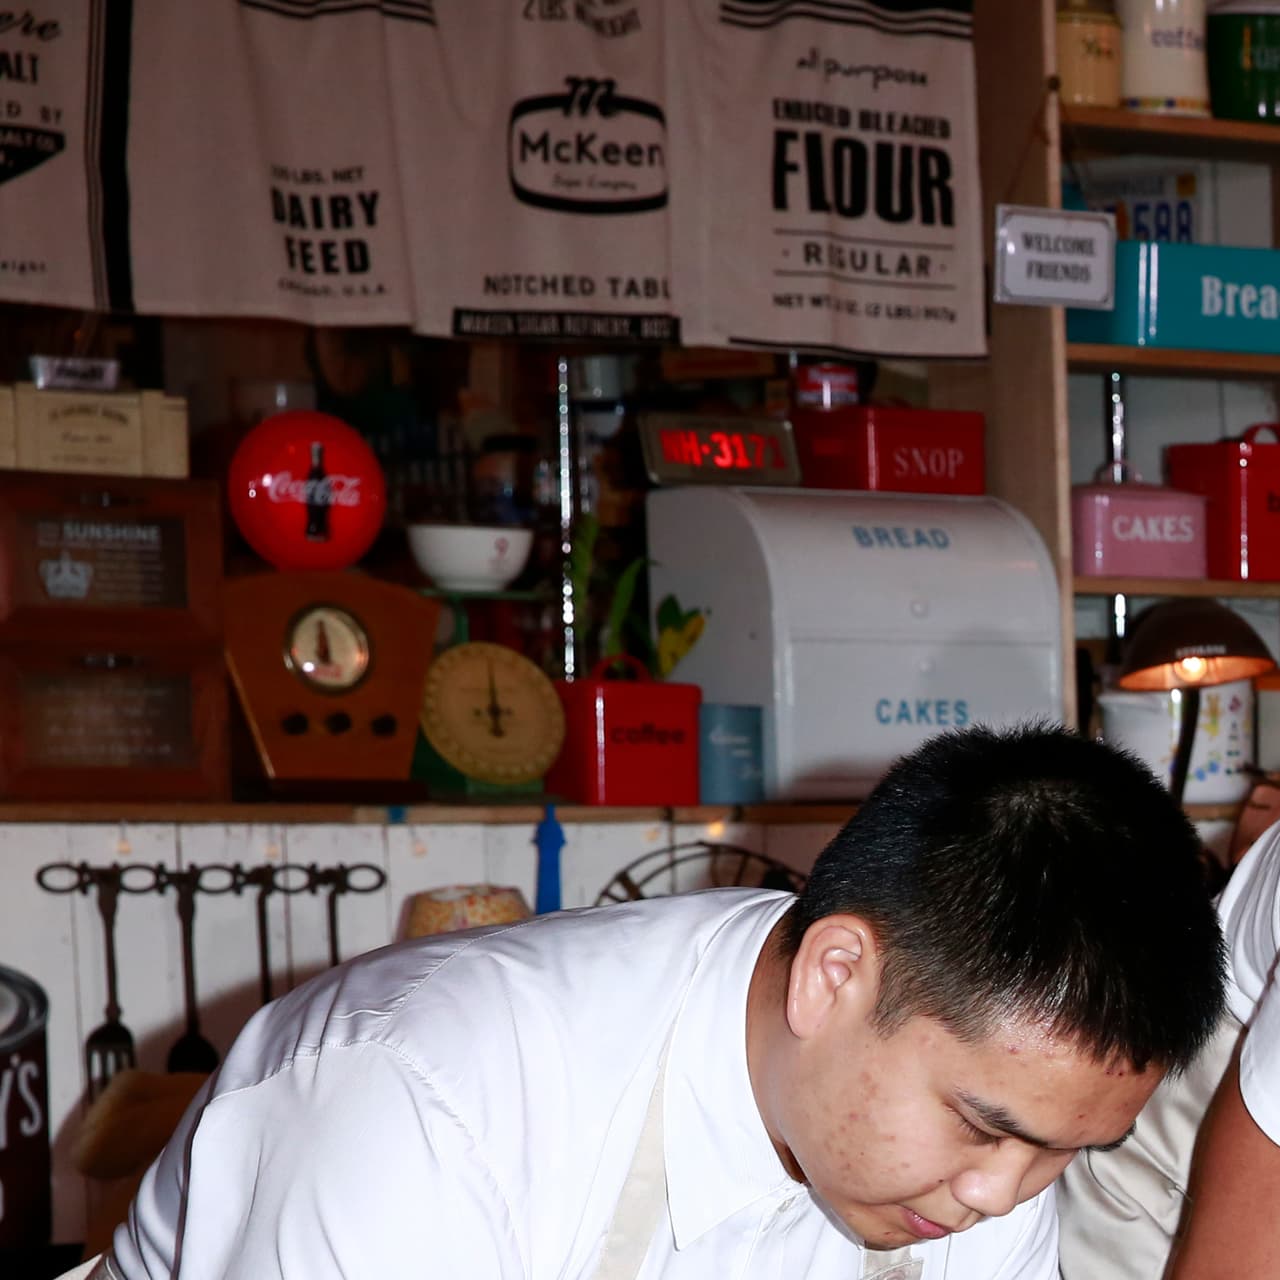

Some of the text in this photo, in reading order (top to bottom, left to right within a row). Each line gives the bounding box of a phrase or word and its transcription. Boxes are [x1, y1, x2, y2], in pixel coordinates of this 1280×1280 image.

[772, 129, 955, 227] FLOUR
[271, 186, 380, 230] DAIRY
[285, 234, 370, 275] FEED
[1022, 231, 1096, 257] WELCOME
[1026, 260, 1091, 284] FRIENDS
[483, 274, 596, 298] NOTCHED
[63, 521, 162, 546] SUNSHINE
[853, 526, 950, 550] BREAD
[1112, 515, 1194, 543] CAKES
[876, 699, 968, 725] CAKES
